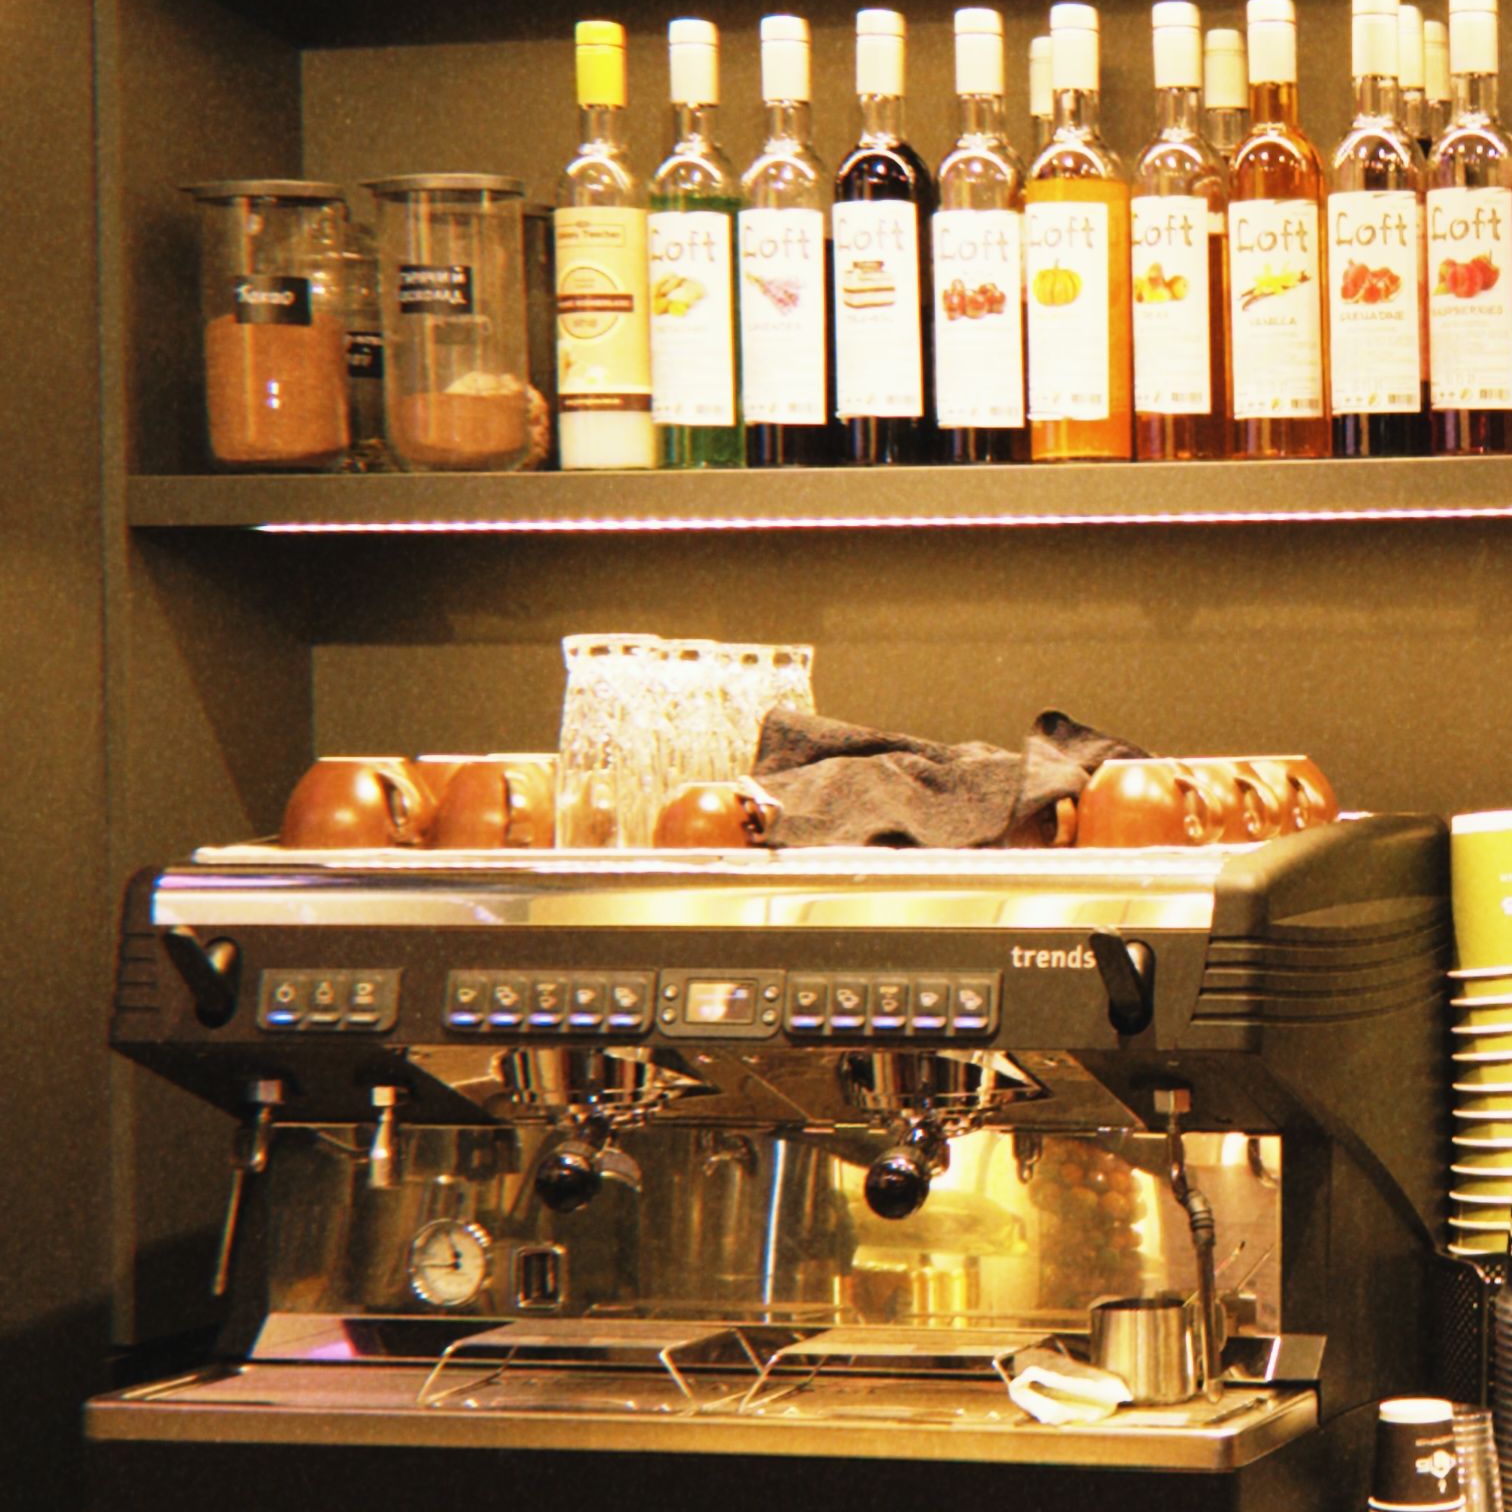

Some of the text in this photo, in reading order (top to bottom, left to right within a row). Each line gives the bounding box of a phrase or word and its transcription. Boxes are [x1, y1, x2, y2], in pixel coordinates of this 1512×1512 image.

[1236, 217, 1310, 254] Loft
[1334, 211, 1408, 248] Loft
[1431, 205, 1502, 244] Loft
[1011, 944, 1097, 968] trends
